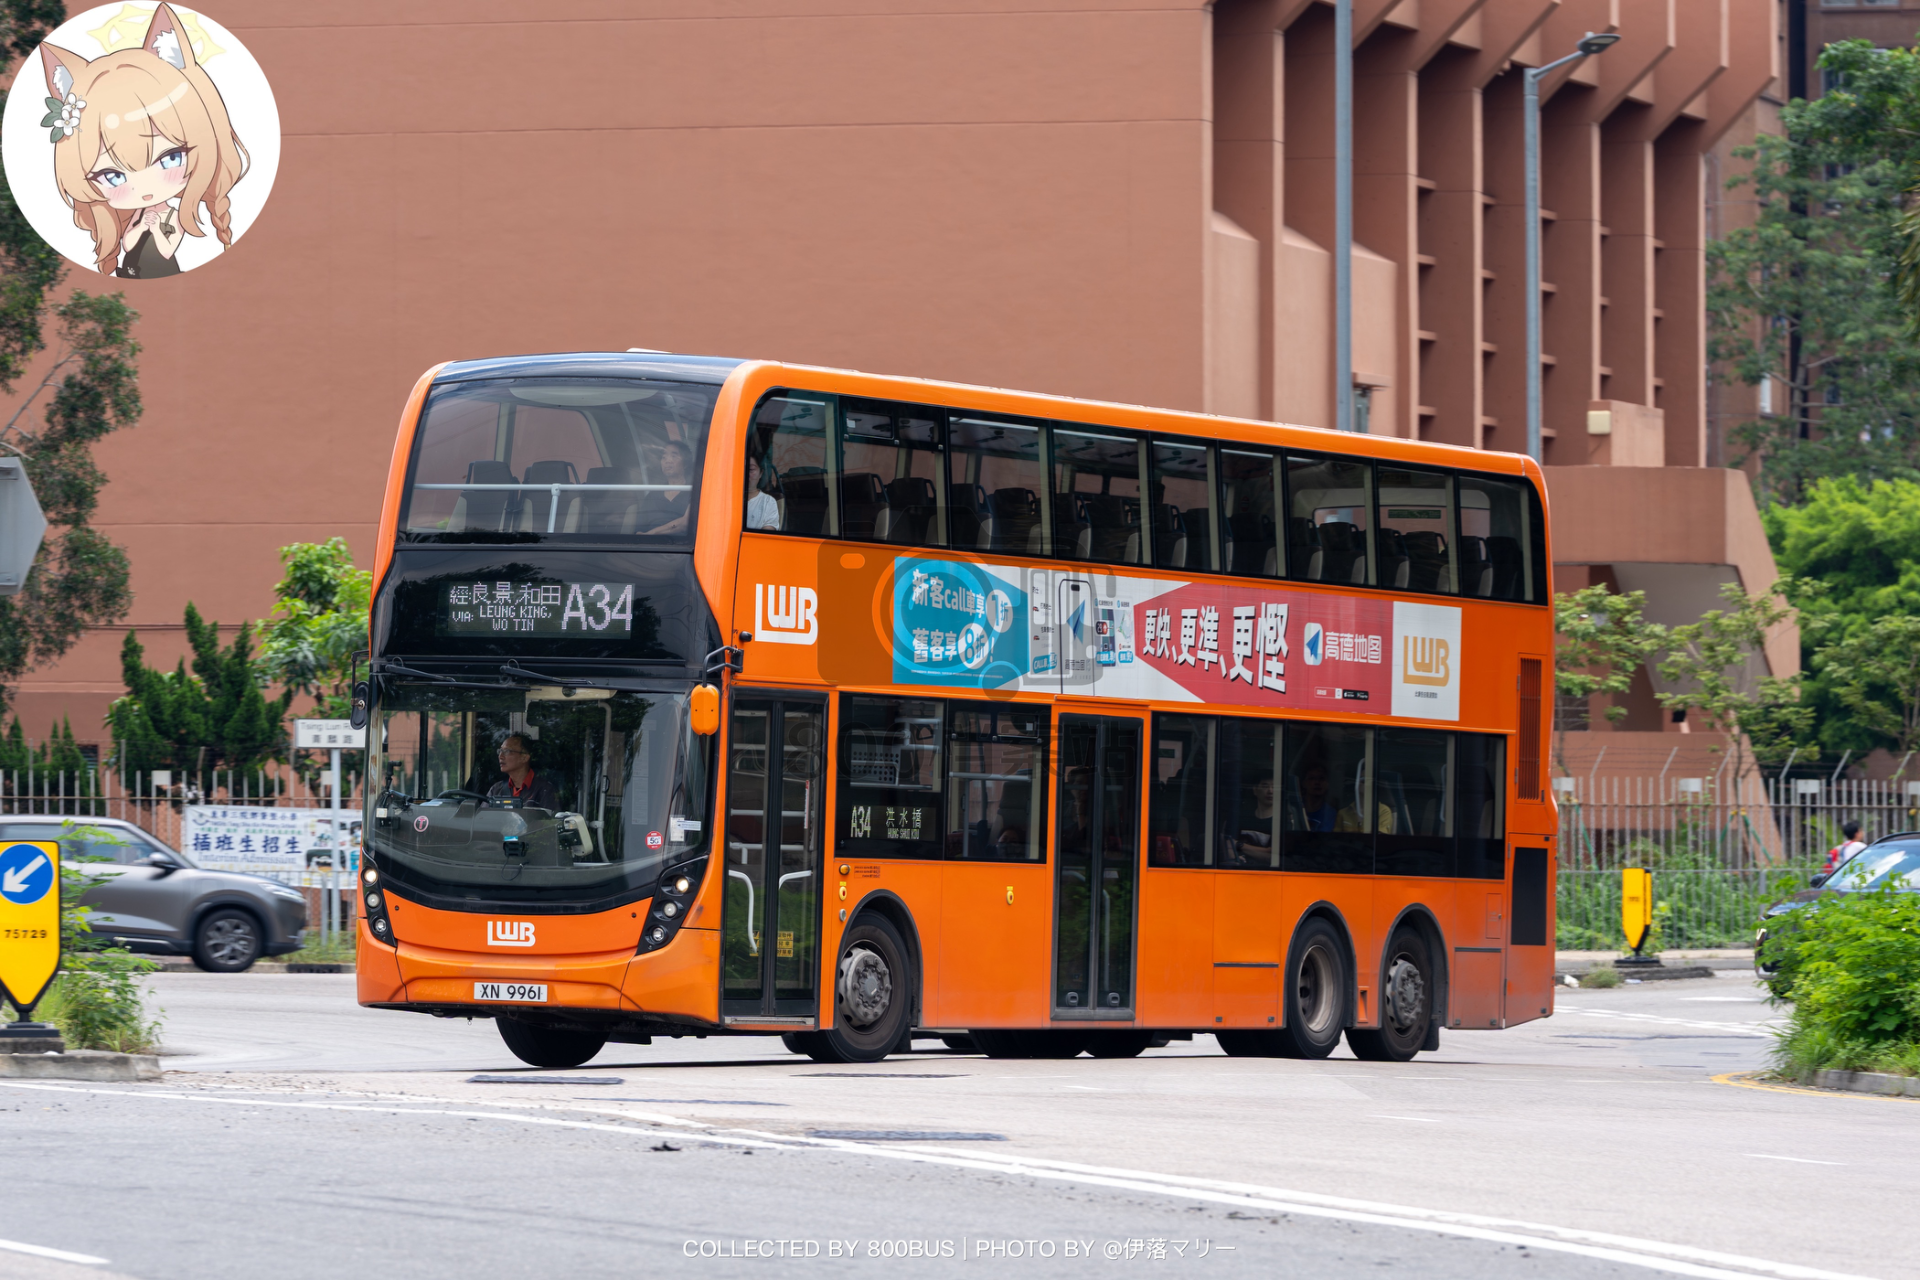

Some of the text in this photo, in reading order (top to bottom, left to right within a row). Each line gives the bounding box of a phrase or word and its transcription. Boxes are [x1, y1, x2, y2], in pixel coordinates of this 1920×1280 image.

[452, 611, 474, 623] VIA:
[479, 605, 516, 618] LEUNG
[561, 583, 633, 631] A34
[754, 583, 818, 646] LWB
[492, 618, 535, 632] WO TIN
[1325, 631, 1382, 664] 高德地图
[1403, 635, 1450, 687] LWB
[850, 805, 871, 838] A34
[192, 833, 303, 854] 插班生招生
[4, 928, 48, 939] 75729
[487, 921, 536, 947] LWB
[481, 984, 541, 1000] XN 9961
